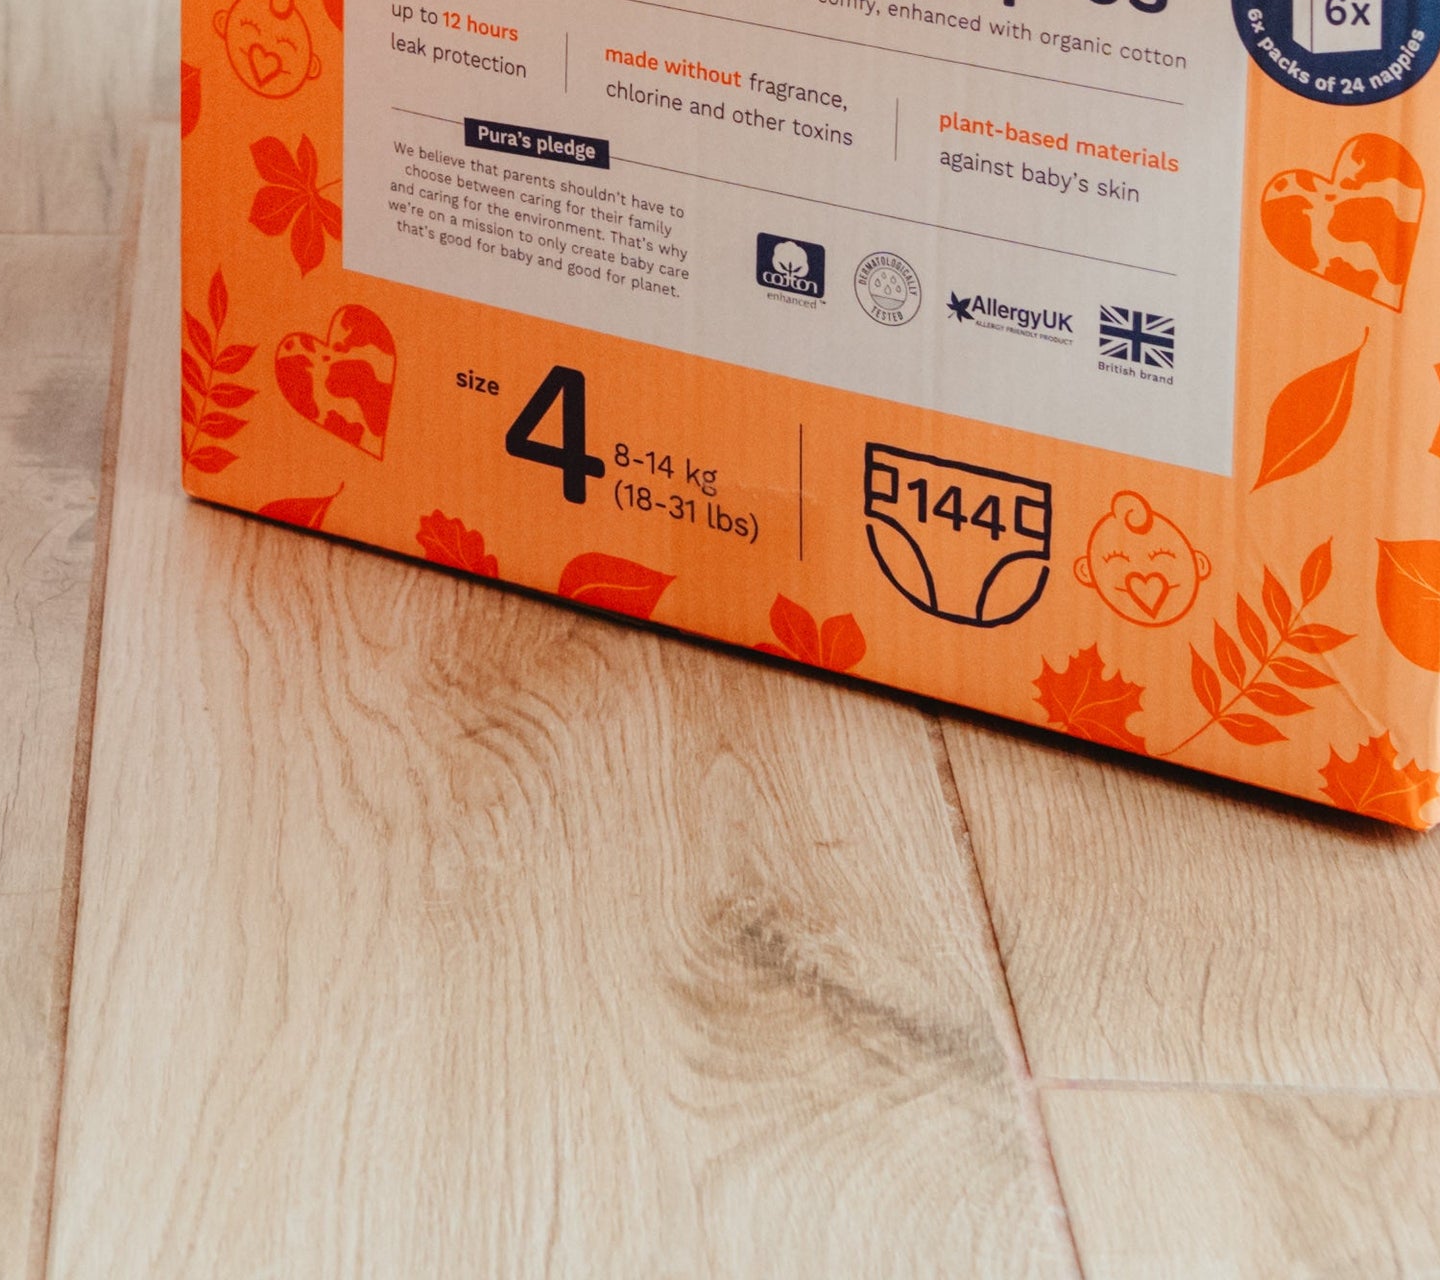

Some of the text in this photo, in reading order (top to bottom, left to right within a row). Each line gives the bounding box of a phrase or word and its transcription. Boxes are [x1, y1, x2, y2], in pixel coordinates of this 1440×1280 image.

[391, 3, 518, 42] up to 12 hours
[887, 3, 981, 32] enhanced
[988, 20, 1031, 41] with
[1040, 31, 1112, 56] organic
[1120, 46, 1186, 68] cotton
[1247, 8, 1425, 95] 6x packs of 24 nappies
[391, 32, 526, 78] leak protection
[604, 48, 847, 112] made without fragrance,
[606, 80, 853, 146] chlorine and other toxins
[938, 111, 1179, 172] plant-based materials
[478, 125, 596, 161] Pura's pledge
[393, 141, 684, 218] We believe that parents shouldn't have to
[940, 151, 1139, 202] against baby's skin
[858, 255, 918, 297] DERMATOLOGICALLY
[870, 307, 905, 322] TESTED
[968, 295, 1073, 333] AllergyUK
[1098, 360, 1174, 385] British brand
[456, 365, 605, 505] size 4
[614, 442, 717, 497] 8-14 kg
[614, 479, 758, 544] (18-31 lbs)
[907, 478, 1006, 541] 144
